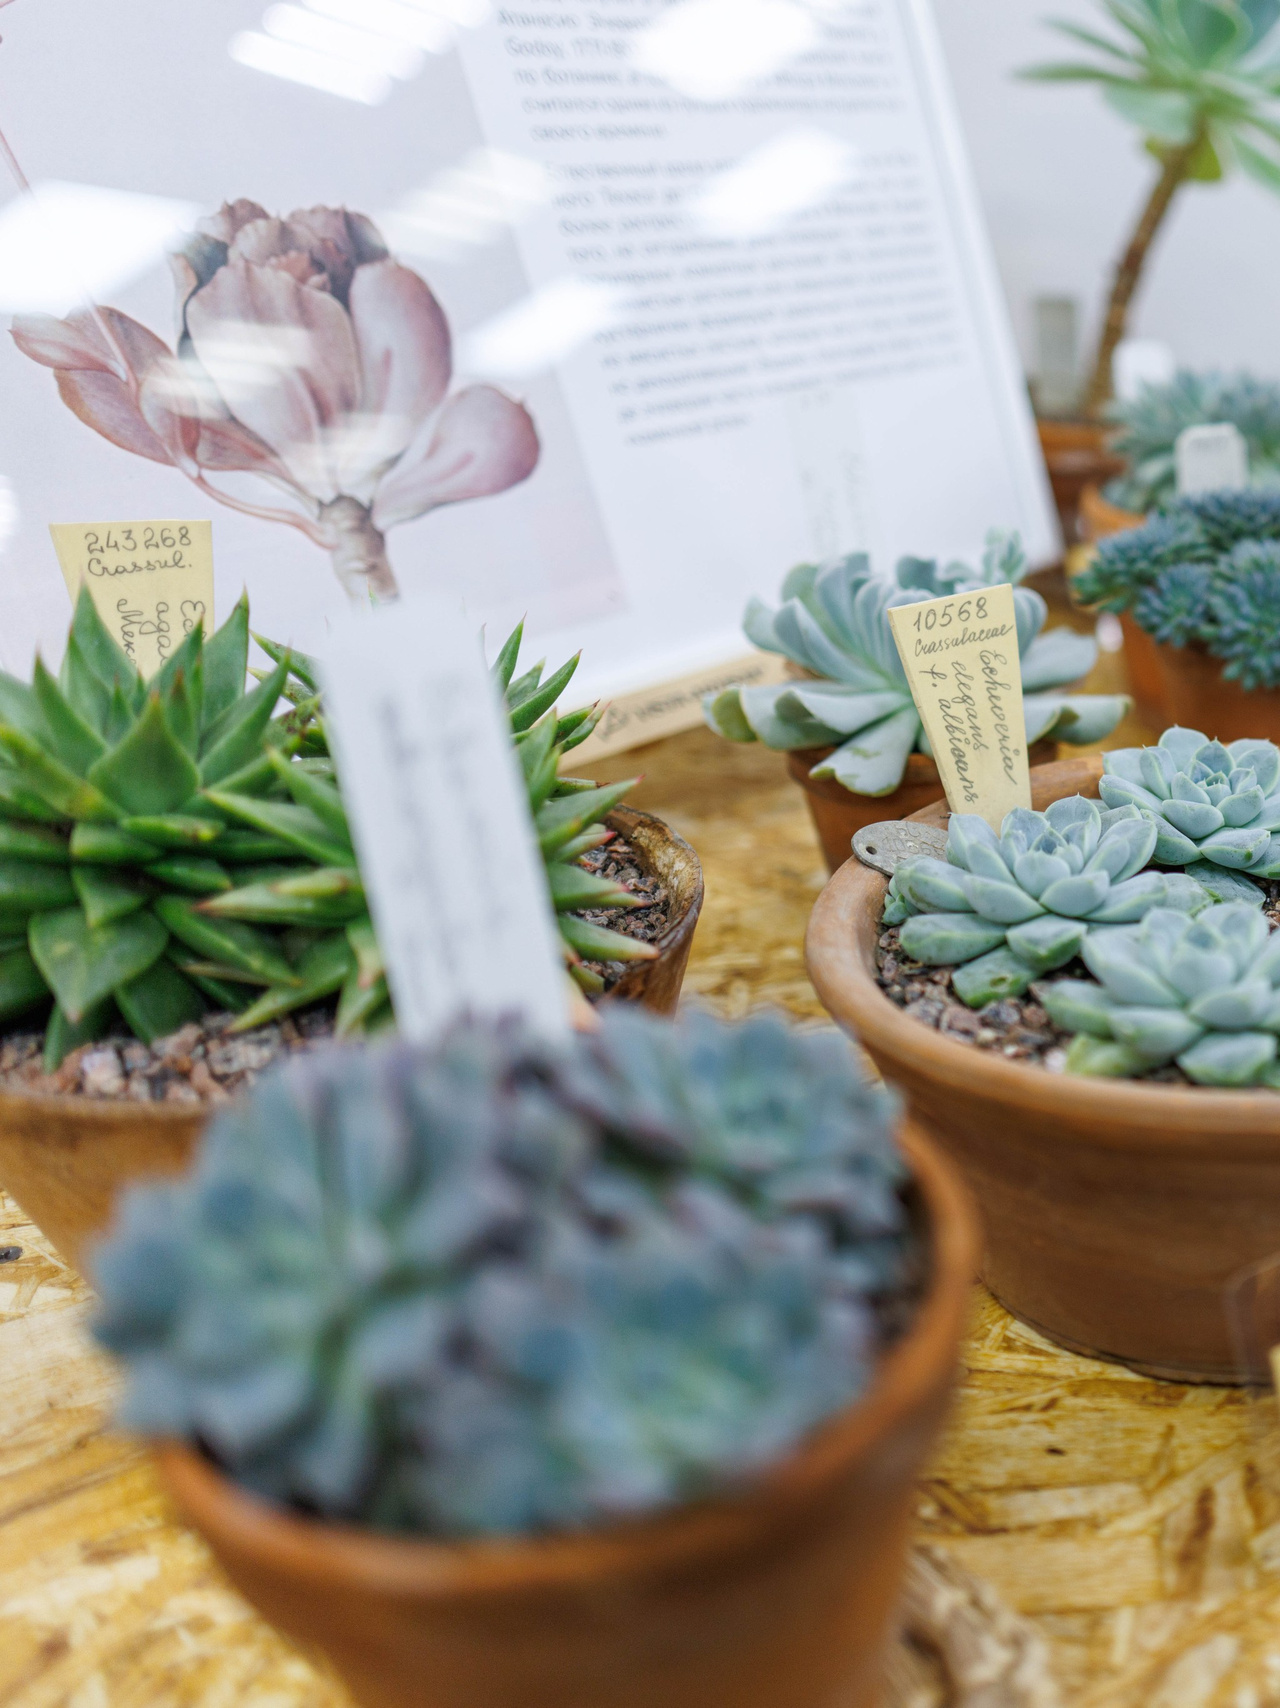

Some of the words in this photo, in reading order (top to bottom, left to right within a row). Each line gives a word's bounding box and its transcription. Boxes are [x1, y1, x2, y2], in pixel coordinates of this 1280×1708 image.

[84, 526, 192, 554] 243268
[913, 596, 988, 632] 10568
[915, 624, 1014, 657] Crassulaceae
[951, 660, 989, 751] elegans
[980, 650, 1018, 786] Echeveria
[938, 698, 979, 804] albicans
